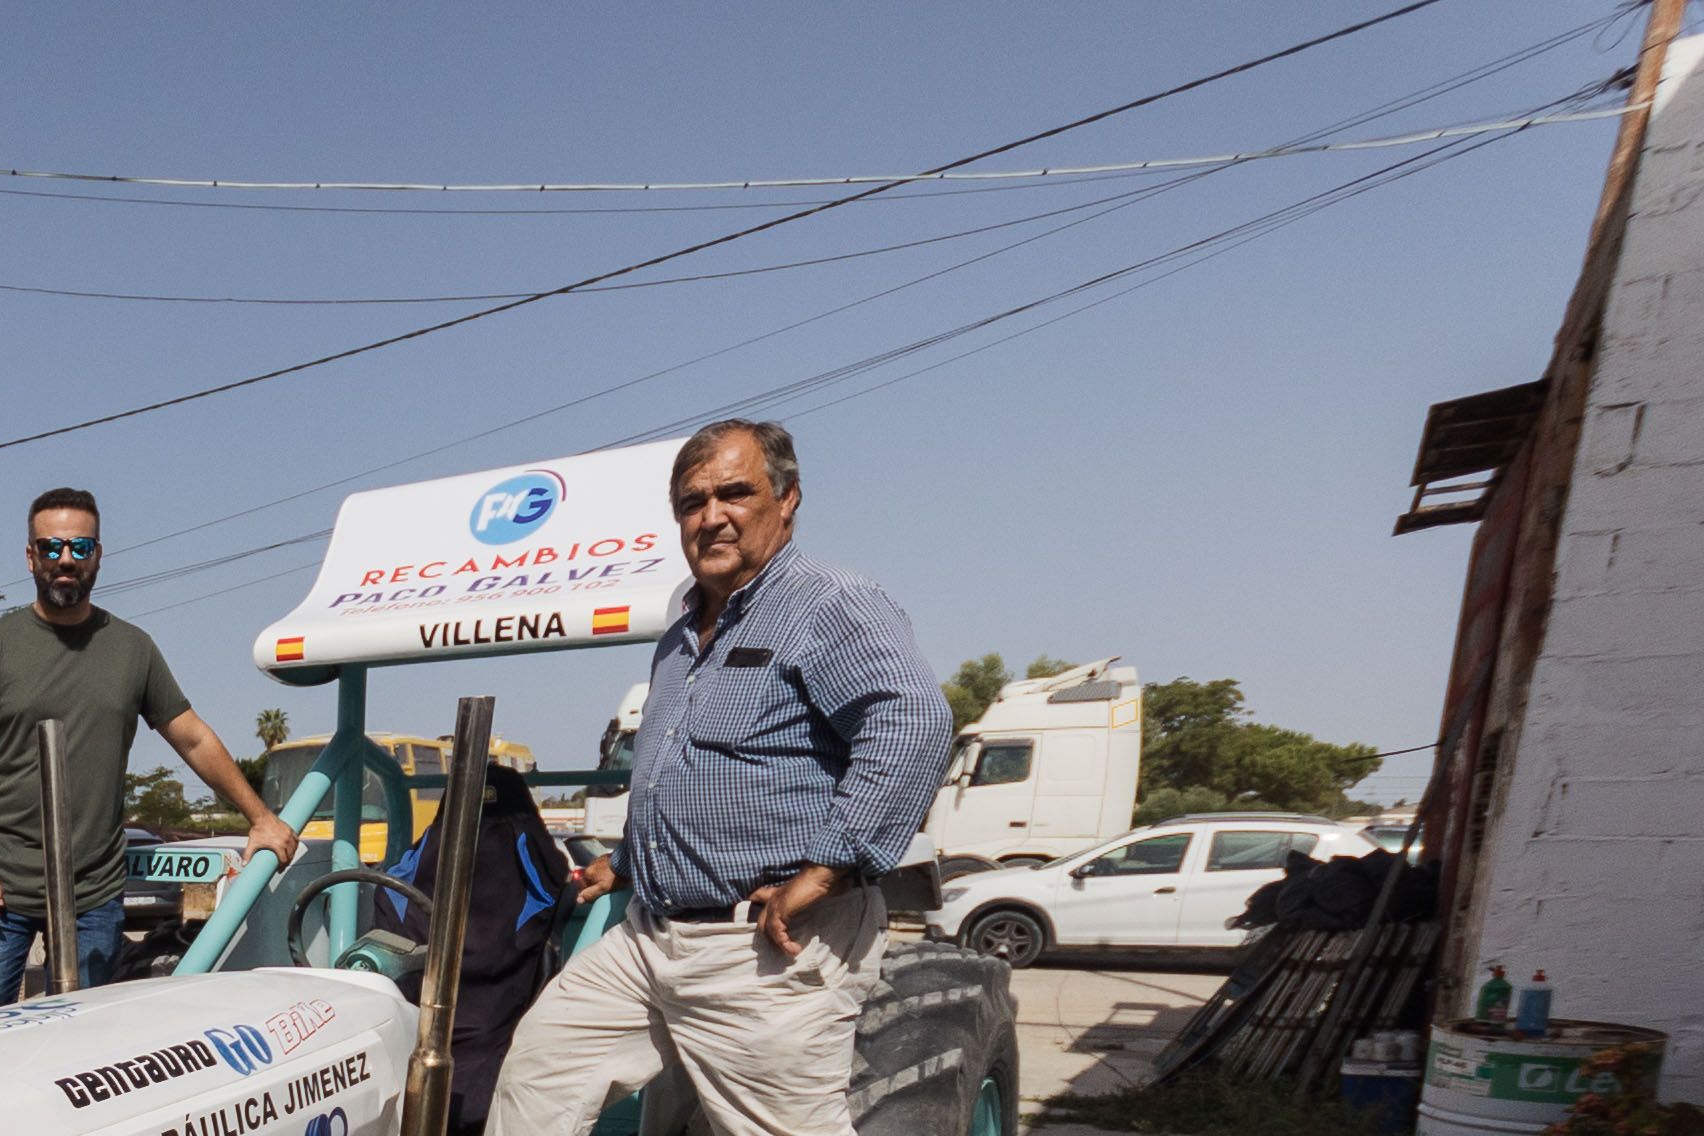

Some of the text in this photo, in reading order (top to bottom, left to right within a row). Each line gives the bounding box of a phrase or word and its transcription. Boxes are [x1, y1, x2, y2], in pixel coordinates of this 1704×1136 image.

[328, 557, 666, 609] PACO GALVEZ
[359, 533, 659, 587] RECAMBIOS
[511, 585, 561, 597] 900
[571, 578, 621, 592] 102
[419, 611, 568, 648] VILLENA
[203, 1024, 273, 1076] GO
[283, 1051, 372, 1115] JIMENEZ
